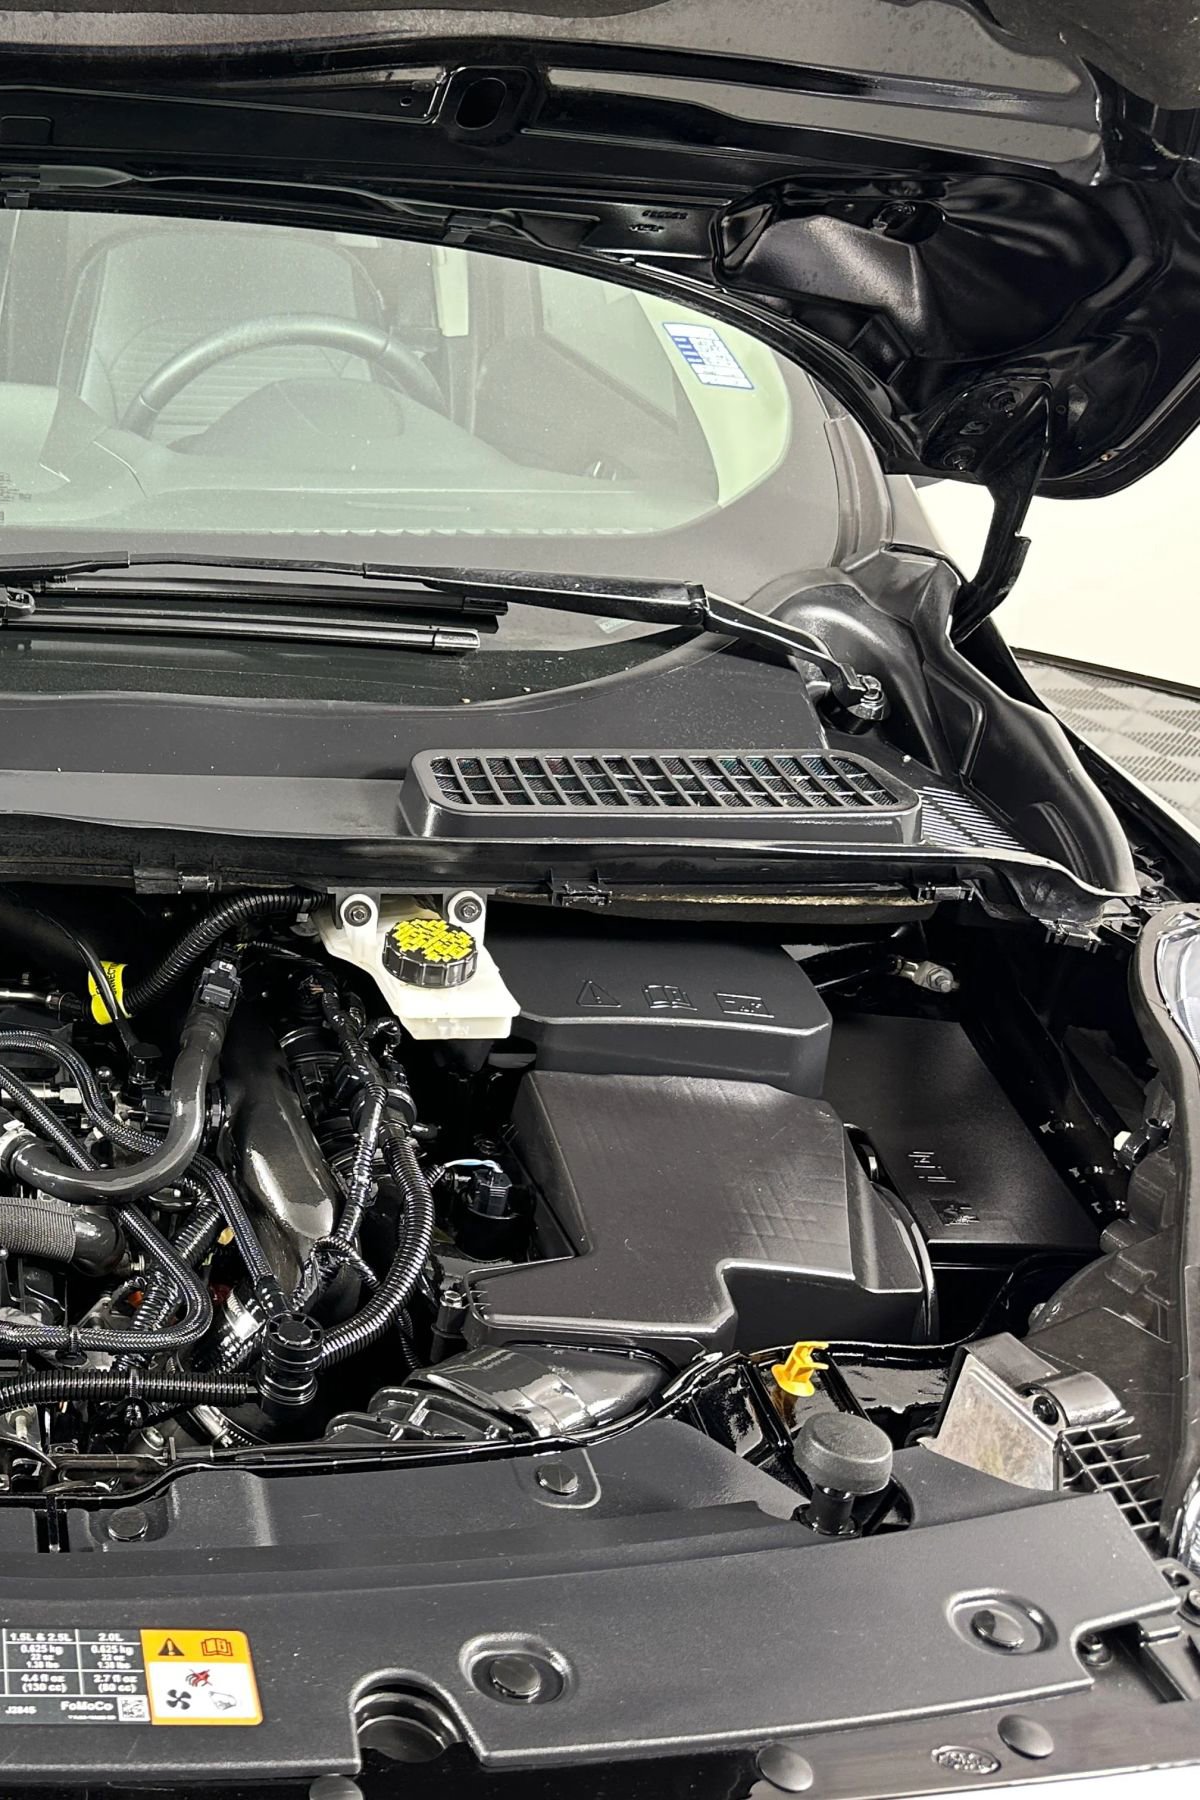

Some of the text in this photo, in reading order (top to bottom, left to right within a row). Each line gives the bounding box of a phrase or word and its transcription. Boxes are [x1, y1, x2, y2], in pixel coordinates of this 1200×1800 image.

[10, 1632, 34, 1641] 1.5L
[47, 1632, 73, 1641] 2.5L
[98, 1632, 124, 1641] 2.0L
[20, 1644, 64, 1656] 0.625 kg
[91, 1645, 134, 1656] 0.625 kg
[20, 1673, 39, 1683] 4.4
[40, 1673, 49, 1682] fl
[93, 1674, 138, 1683] 2.7 fl oz
[22, 1683, 68, 1693] (130 cc)
[117, 1683, 137, 1693] cc)
[60, 1700, 114, 1711] FoMoCo
